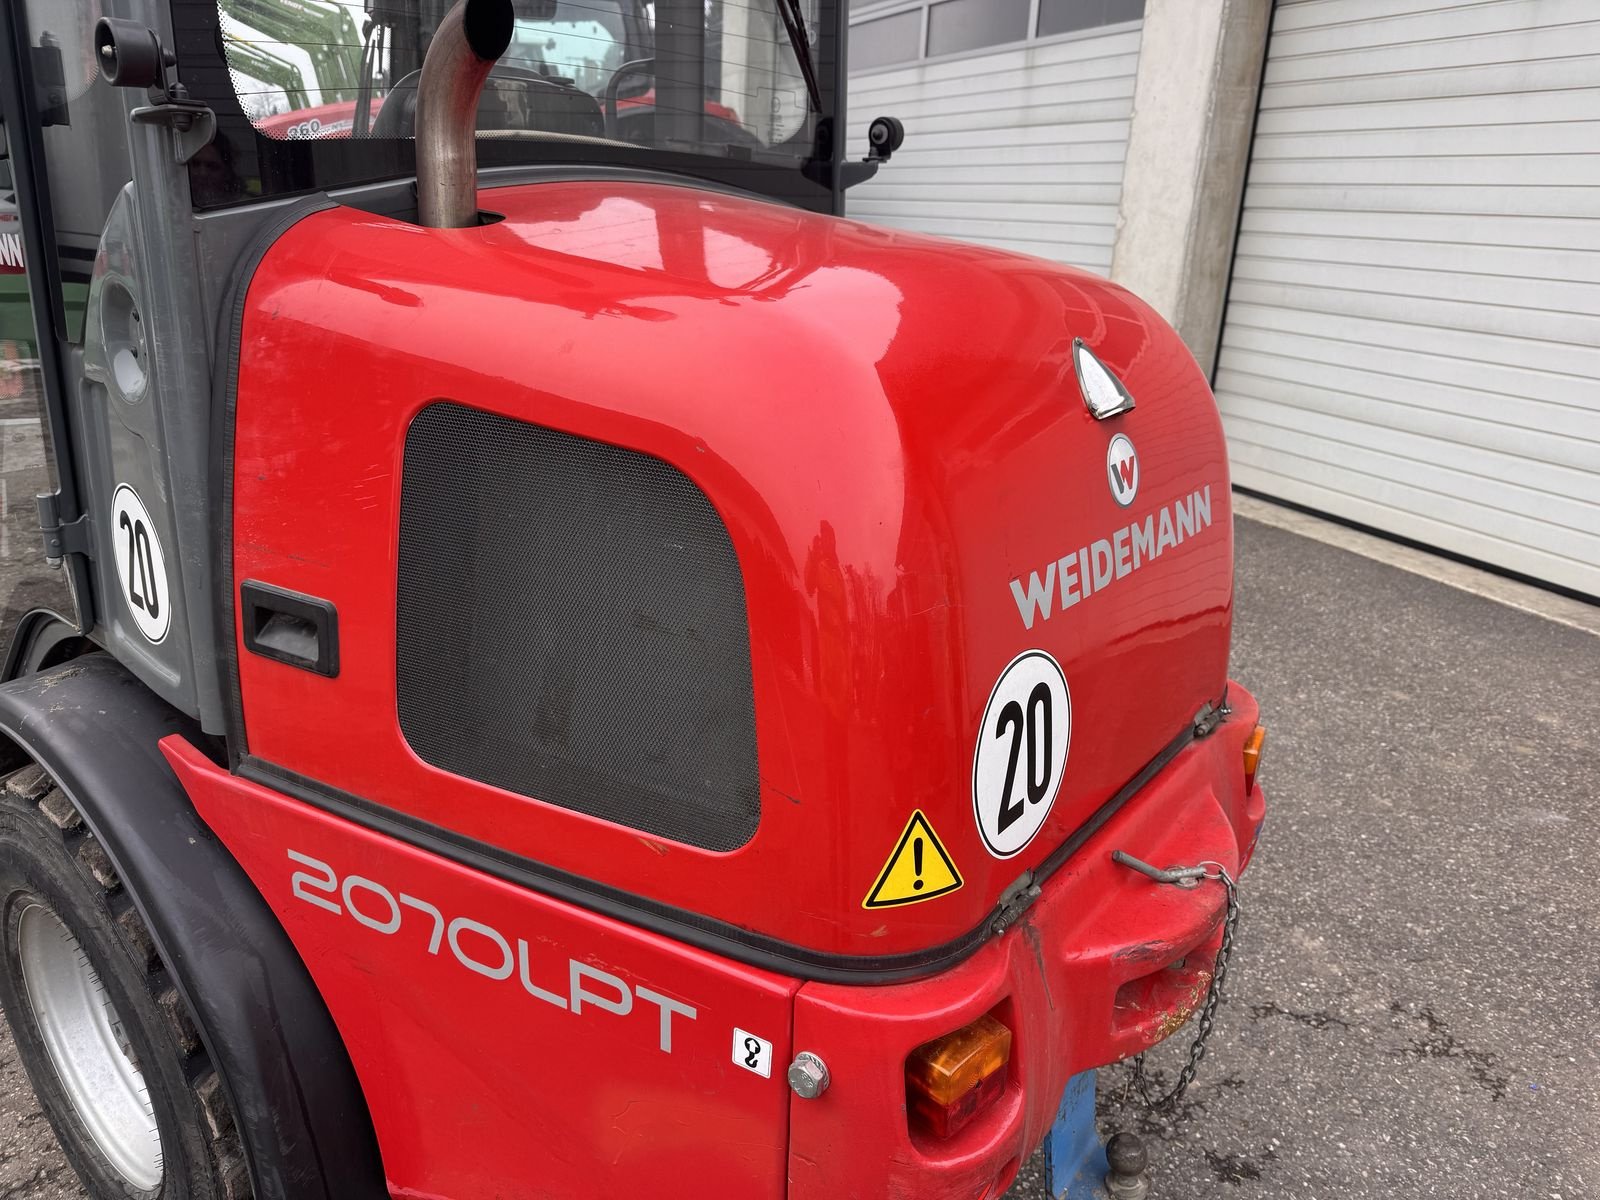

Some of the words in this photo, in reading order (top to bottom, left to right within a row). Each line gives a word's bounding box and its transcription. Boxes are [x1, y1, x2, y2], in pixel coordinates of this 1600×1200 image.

[1110, 455, 1135, 495] W
[119, 510, 160, 620] 20
[1009, 486, 1213, 630] WEIDEMANN
[995, 681, 1054, 836] 20
[286, 848, 698, 1054] 2070LPT
